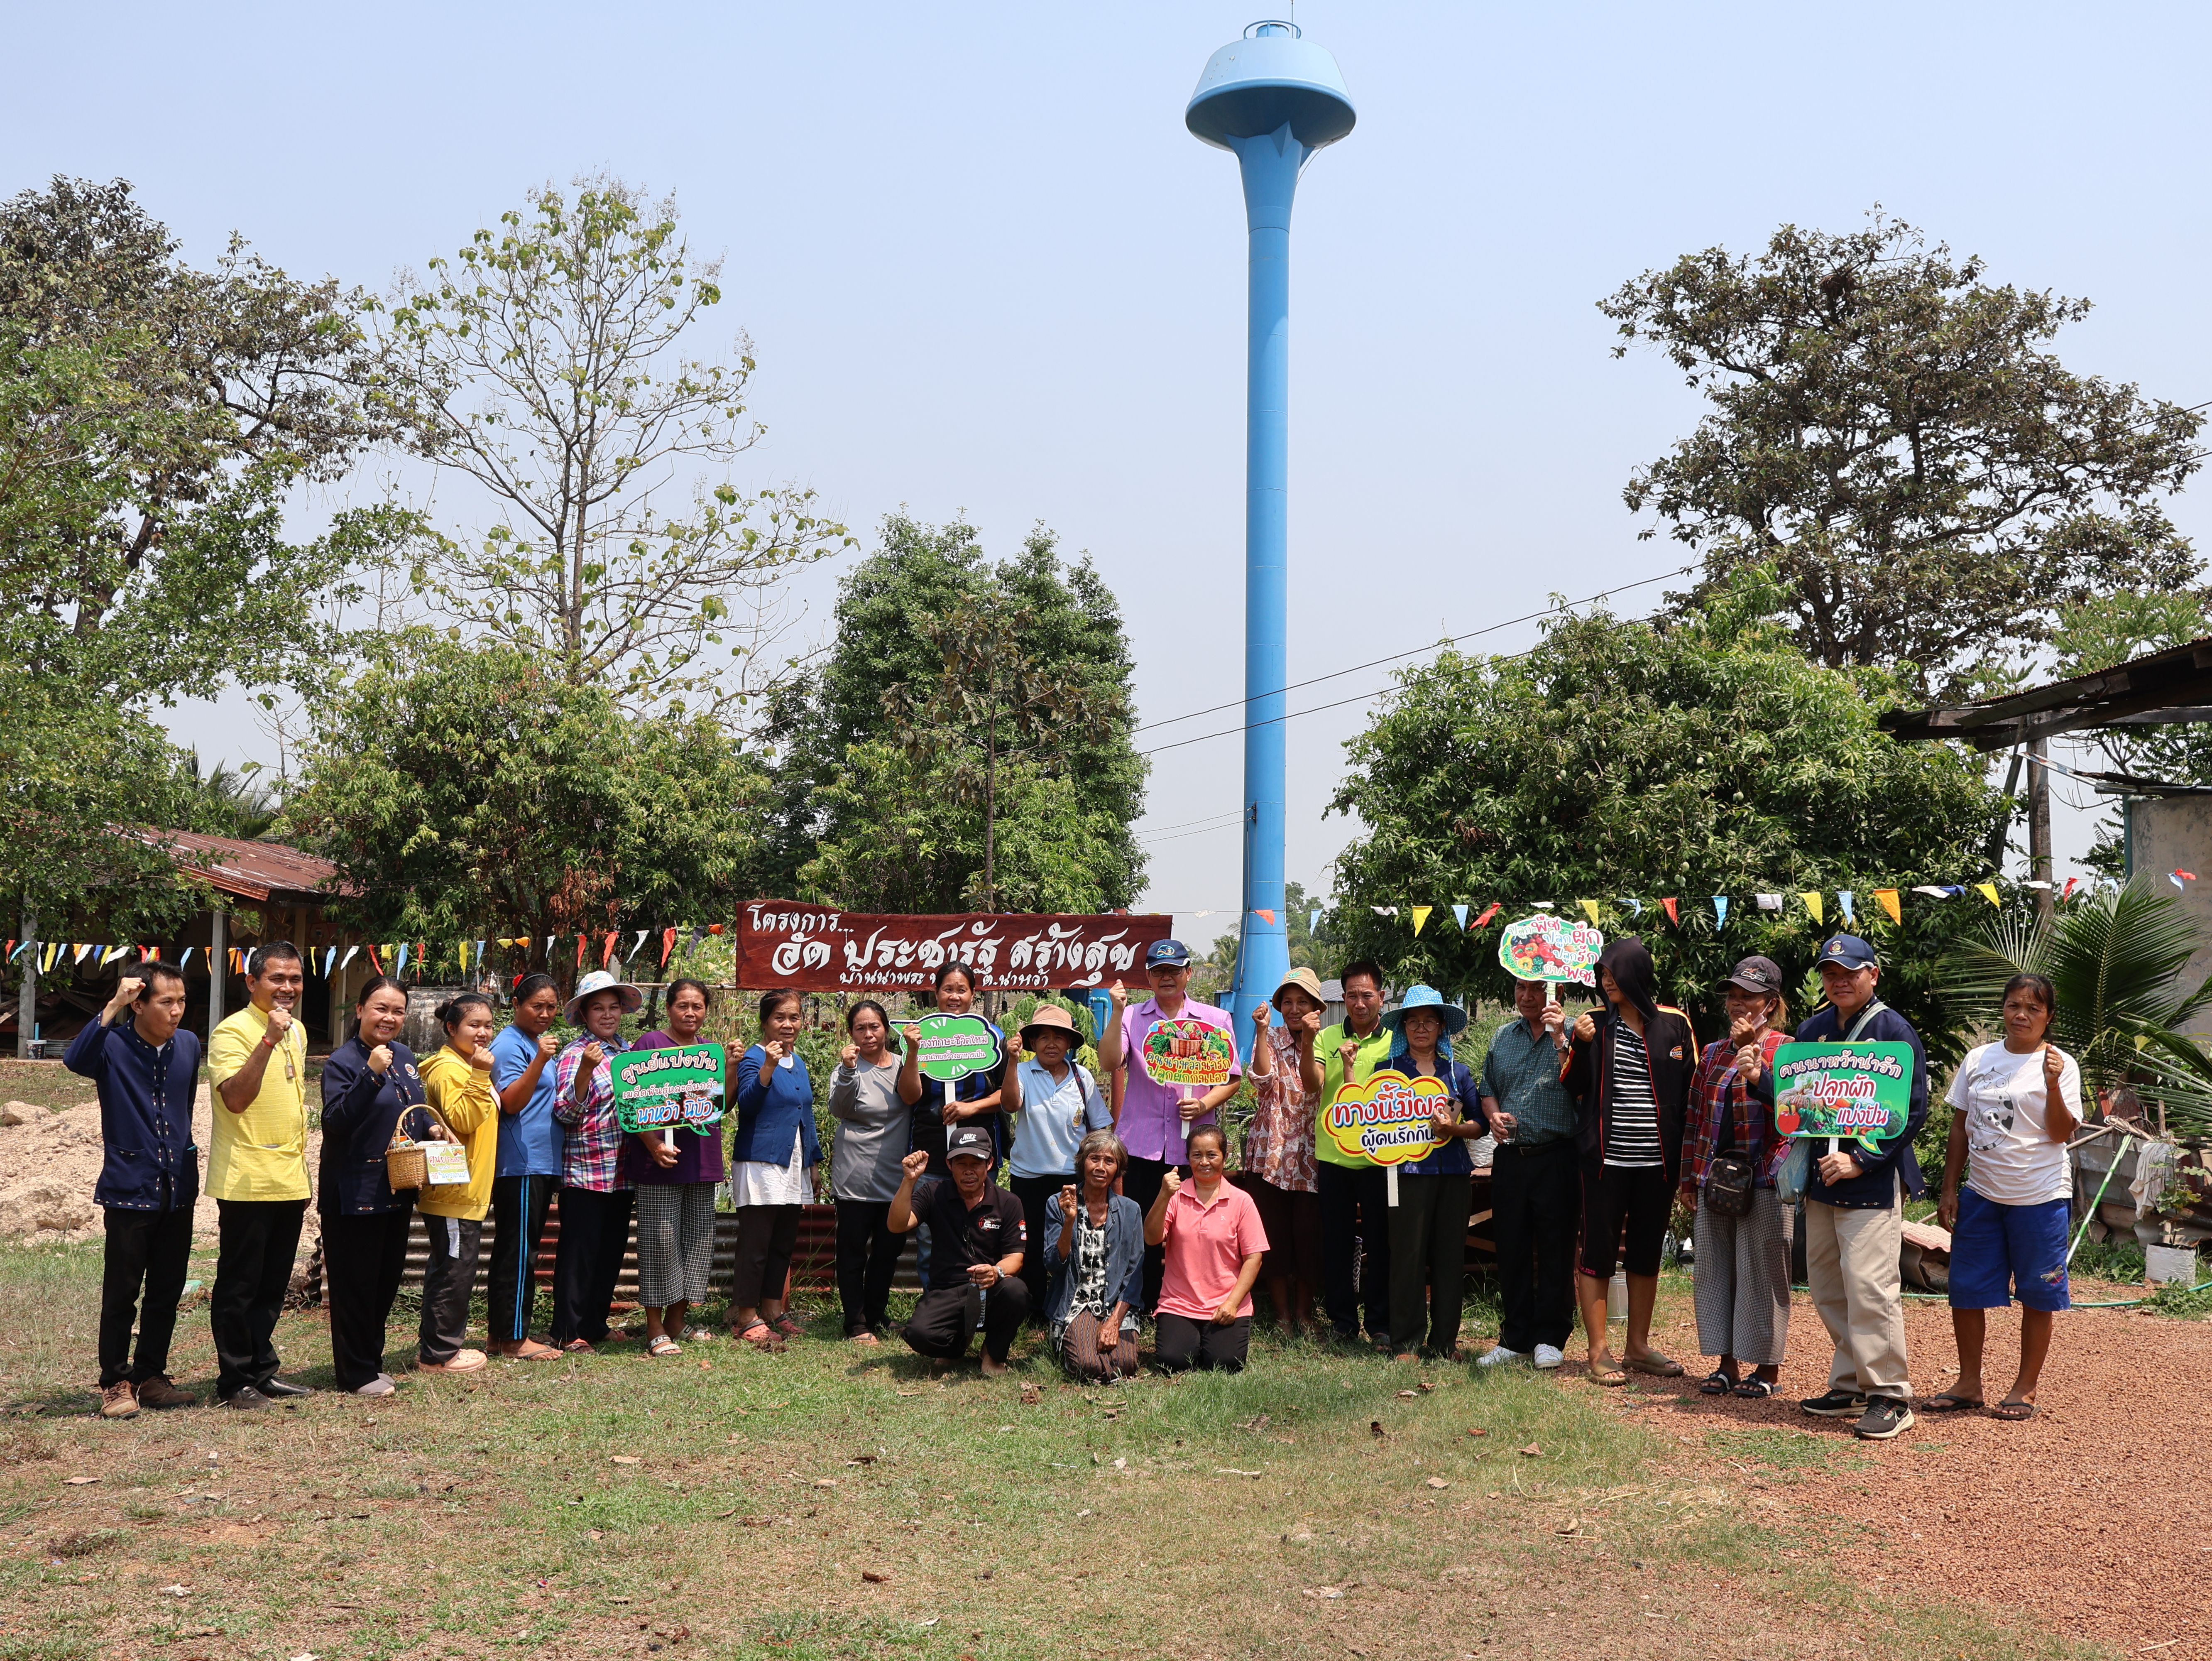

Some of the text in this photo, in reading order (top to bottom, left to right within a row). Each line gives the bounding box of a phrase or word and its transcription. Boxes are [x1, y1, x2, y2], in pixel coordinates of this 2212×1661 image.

[1543, 924, 1600, 947] ปลูกผัก
[843, 919, 1005, 975] ประชารัฐ
[1010, 922, 1141, 987] สร้างสุข
[1553, 945, 1598, 963] ปลูกรัก
[982, 968, 1050, 987] ต.นาหว้า
[905, 1030, 989, 1049] างทักษะชีวิตใหม่
[916, 1049, 986, 1062] าวชนไทยสร้างอาหารเป็น
[1146, 1052, 1231, 1071] คนนาหว้าน่ารัก
[1780, 1050, 1902, 1078] คนนาหว้าน่ารัก
[621, 1050, 717, 1084] ศูนย์แบ่งปัน
[1148, 1065, 1228, 1083] ปลูกผักกินเอง
[623, 1078, 718, 1098] เมล็ดพันธุ์และต้นกล้า
[1814, 1073, 1874, 1104] ปลูกผัก
[638, 1098, 712, 1123] นาหว้า นิบัว
[1837, 1103, 1887, 1124] แบ่งปัน
[1361, 1124, 1435, 1153] ผู้คนรักกัน
